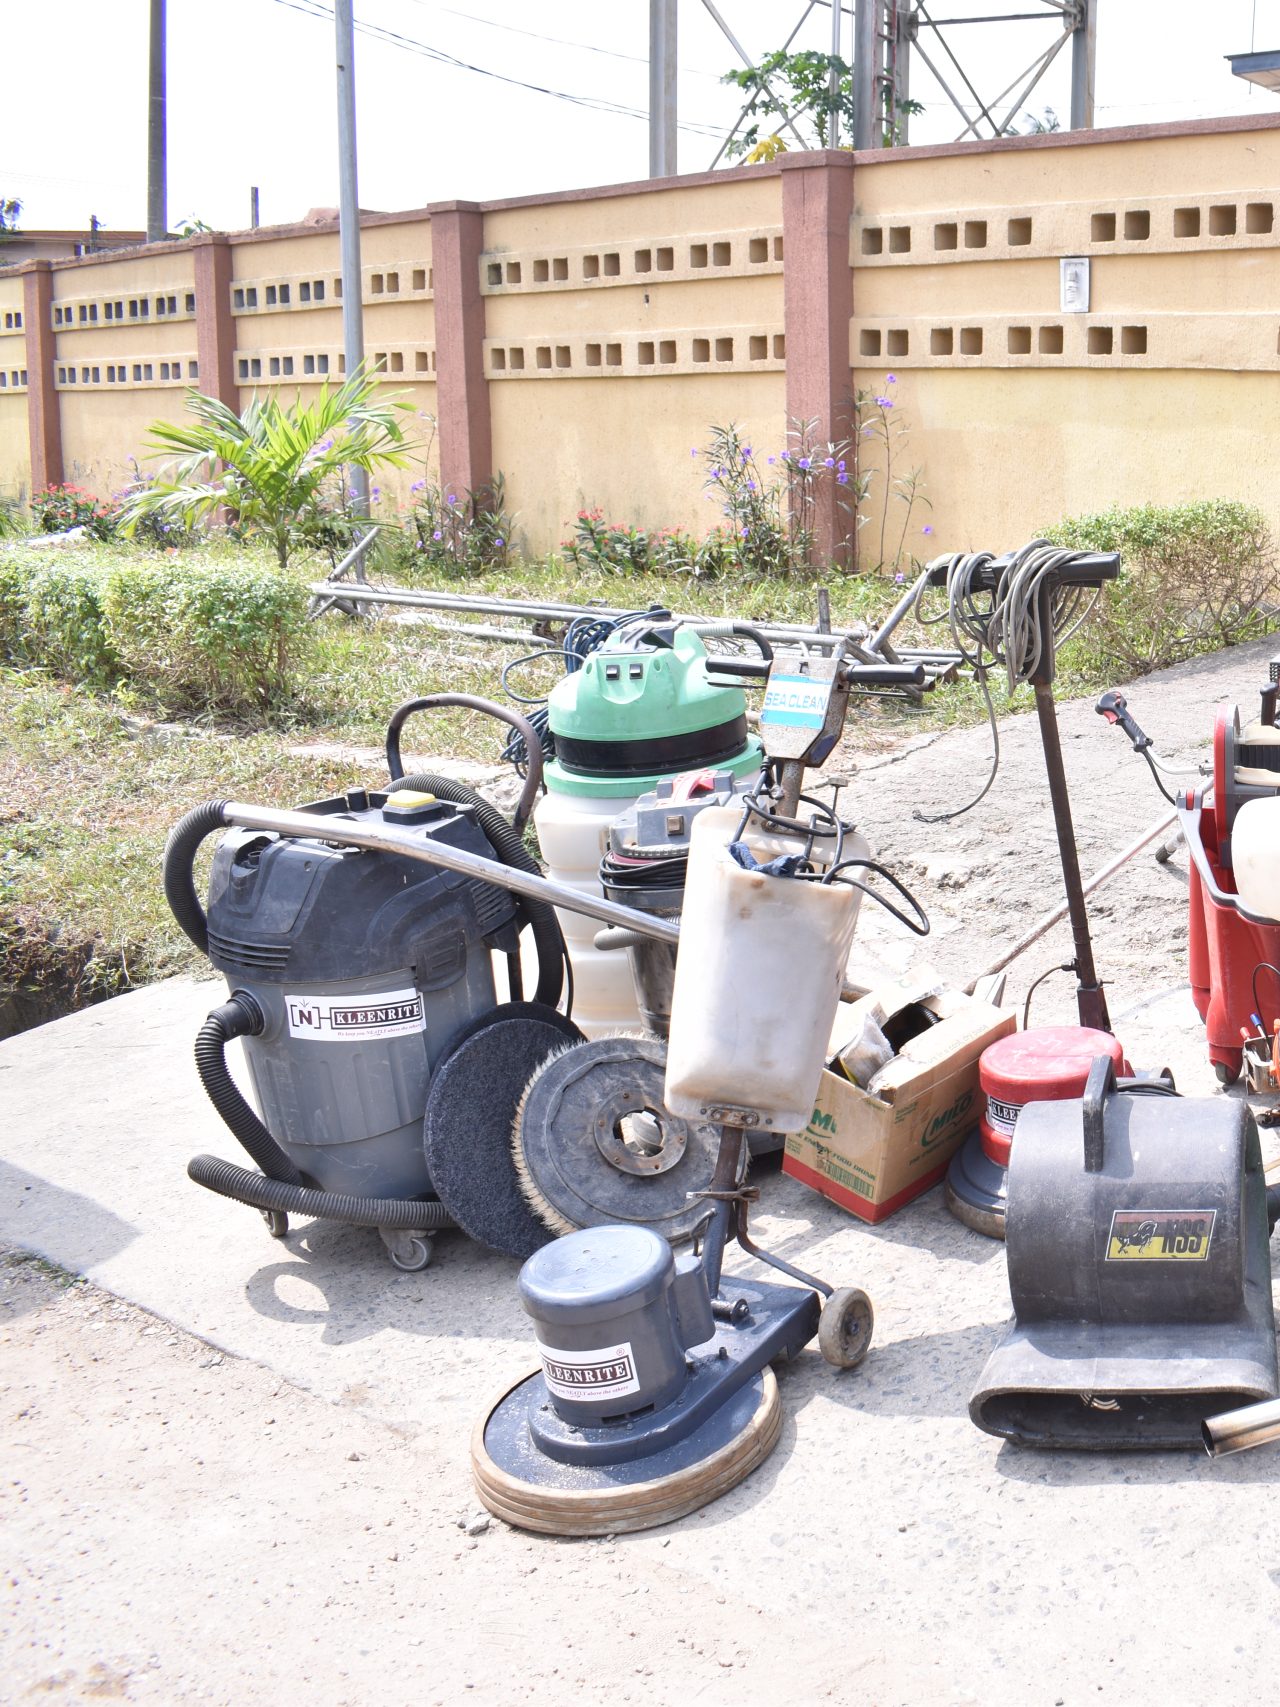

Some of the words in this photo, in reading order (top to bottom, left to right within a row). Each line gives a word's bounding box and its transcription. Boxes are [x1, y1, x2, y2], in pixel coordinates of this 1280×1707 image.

[764, 692, 787, 707] SEA
[788, 694, 827, 711] CLEAN
[335, 1003, 420, 1024] KLEENRITE
[992, 1102, 1020, 1120] KLEE
[1162, 1218, 1206, 1254] NSS
[543, 1360, 626, 1383] KLEENRITE
